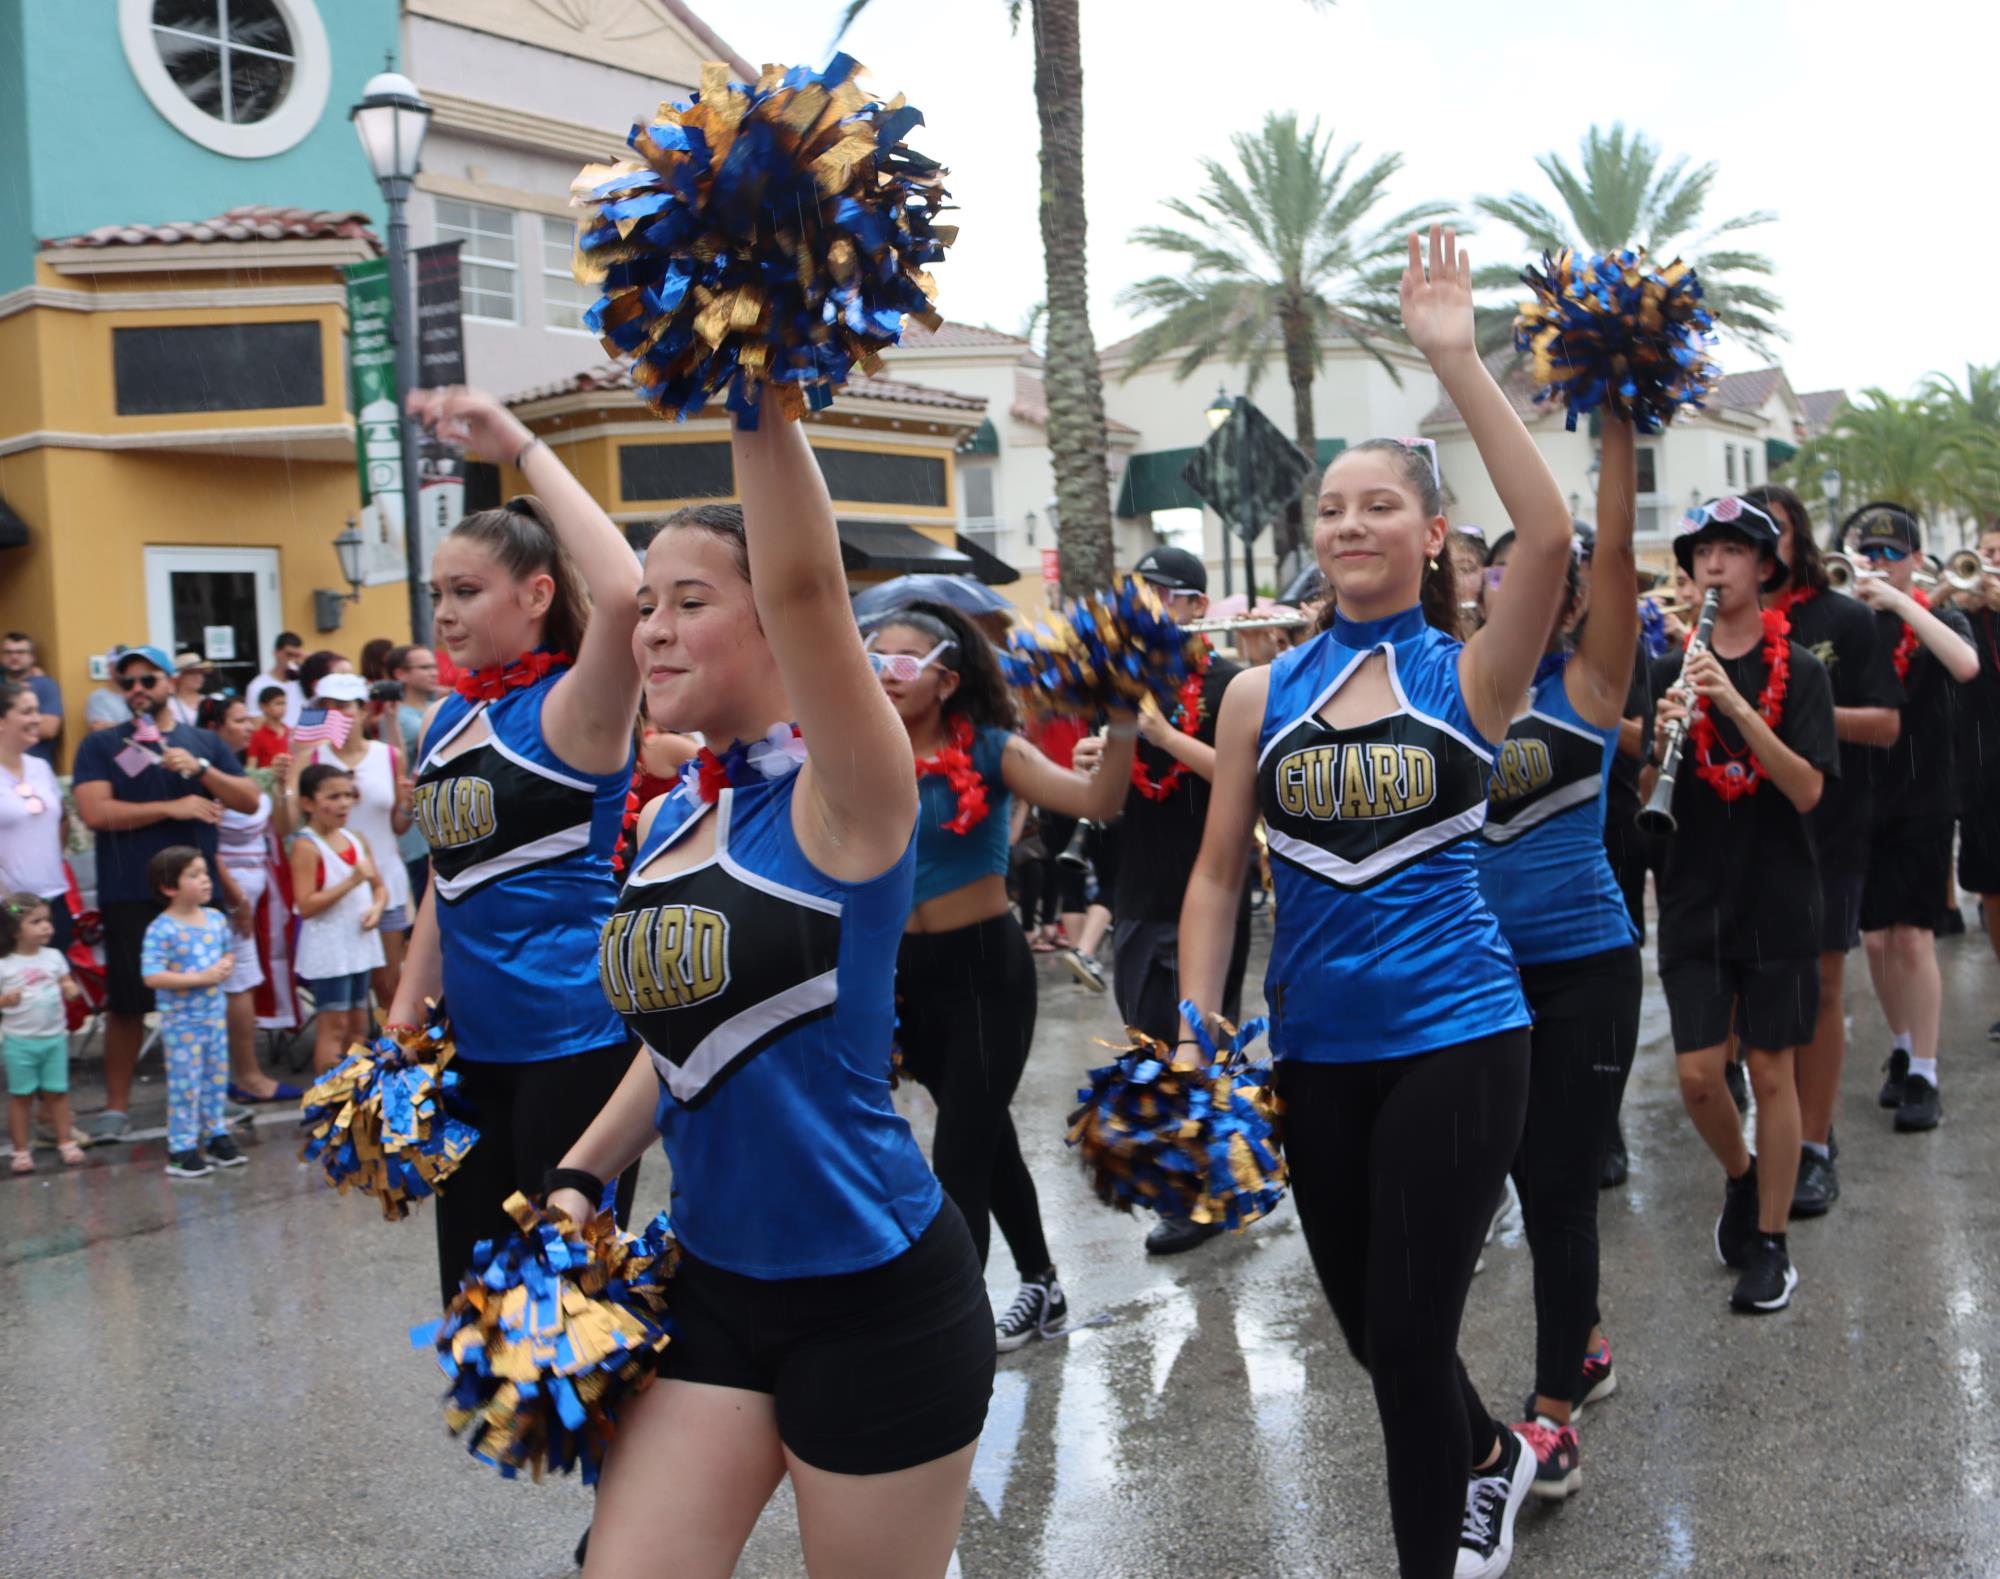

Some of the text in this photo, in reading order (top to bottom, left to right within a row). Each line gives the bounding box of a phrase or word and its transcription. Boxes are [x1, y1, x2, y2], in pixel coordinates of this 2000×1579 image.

[414, 776, 498, 848] UARD
[1276, 743, 1437, 821] GUARD
[599, 904, 731, 1013] UARD
